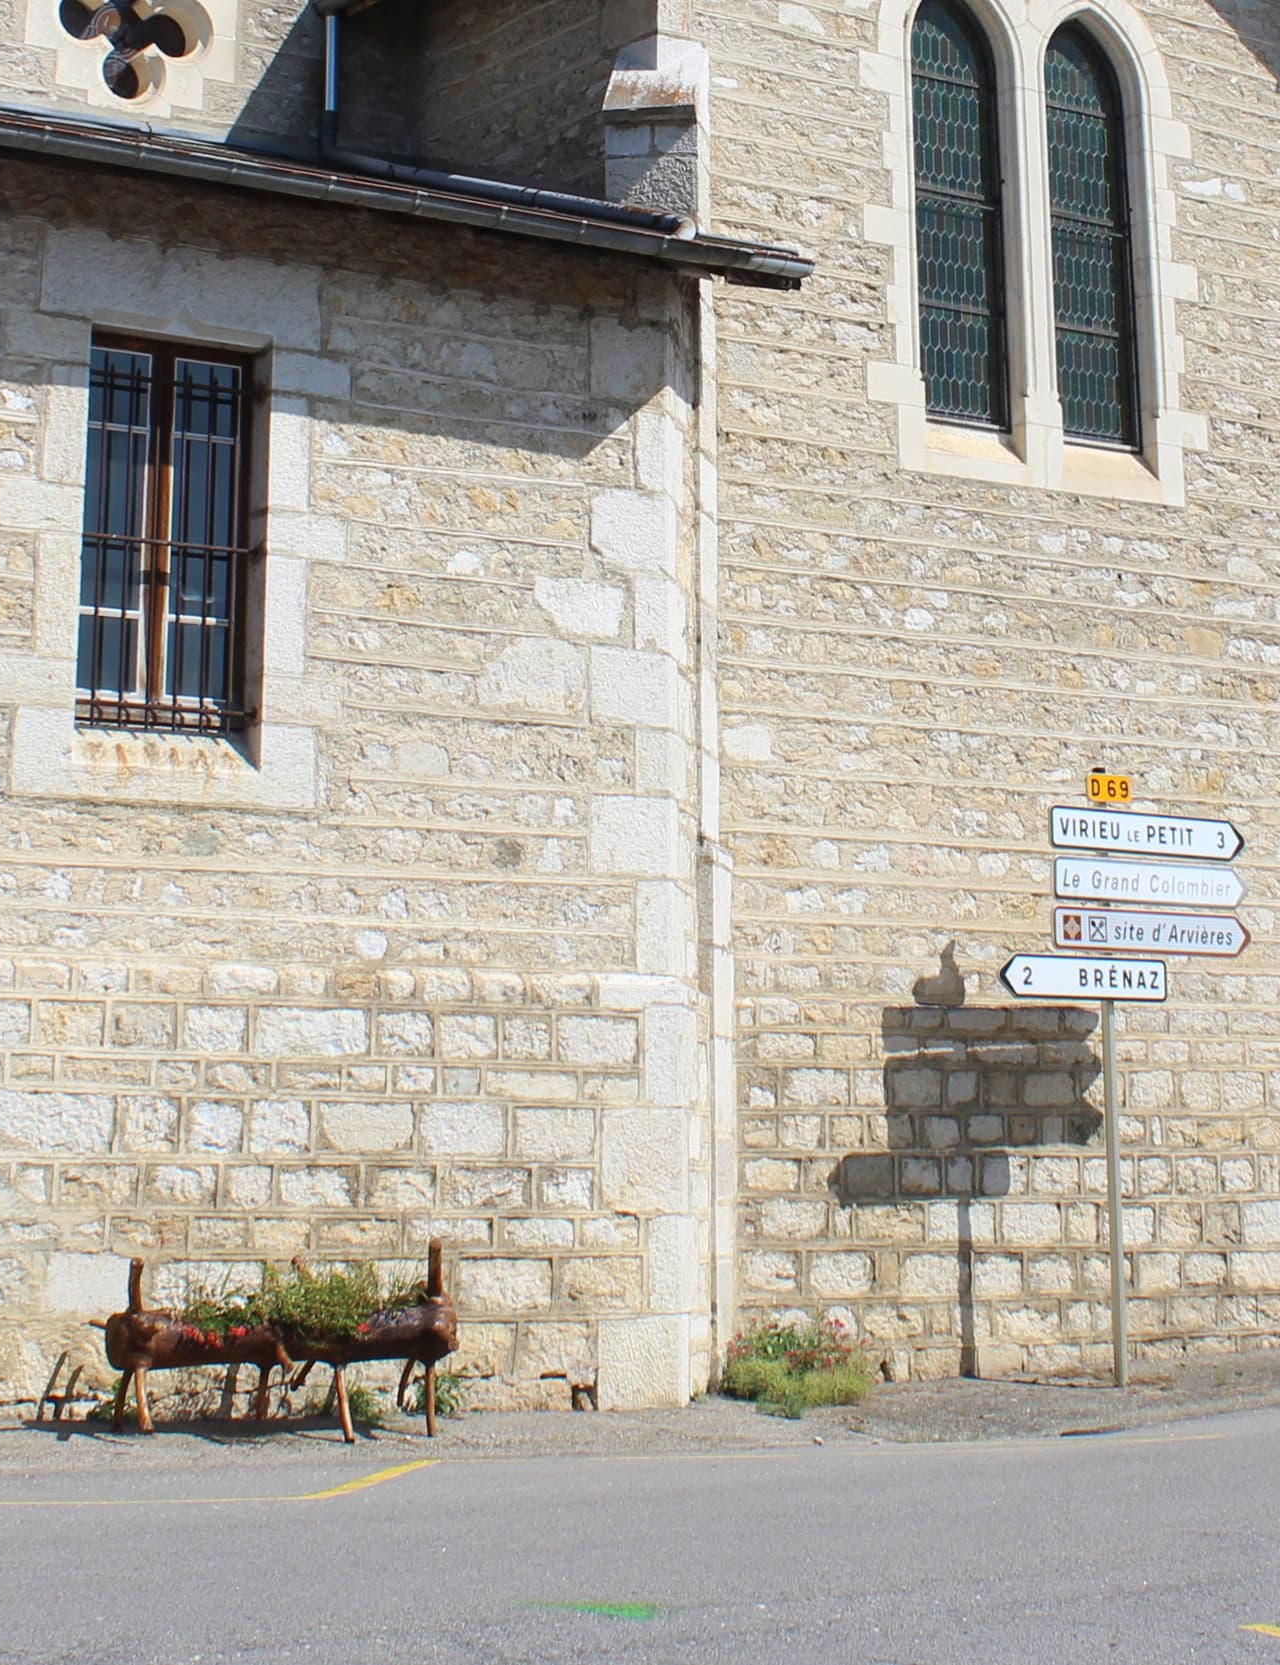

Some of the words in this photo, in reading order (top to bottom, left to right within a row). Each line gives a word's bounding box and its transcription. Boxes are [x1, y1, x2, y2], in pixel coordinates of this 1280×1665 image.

[1091, 778, 1101, 797] D
[1107, 780, 1129, 798] 69
[1060, 817, 1120, 840] VIRIEU
[1127, 830, 1140, 842] LE
[1146, 825, 1193, 846] PETIT
[1216, 831, 1225, 849] 3
[1063, 868, 1080, 888] Le
[1091, 870, 1140, 892] Grand
[1149, 874, 1231, 897] Colombier
[1114, 921, 1144, 941] site
[1152, 922, 1233, 946] d'Arvières
[1023, 966, 1032, 985] 2
[1079, 965, 1159, 989] BRÉNAZ
